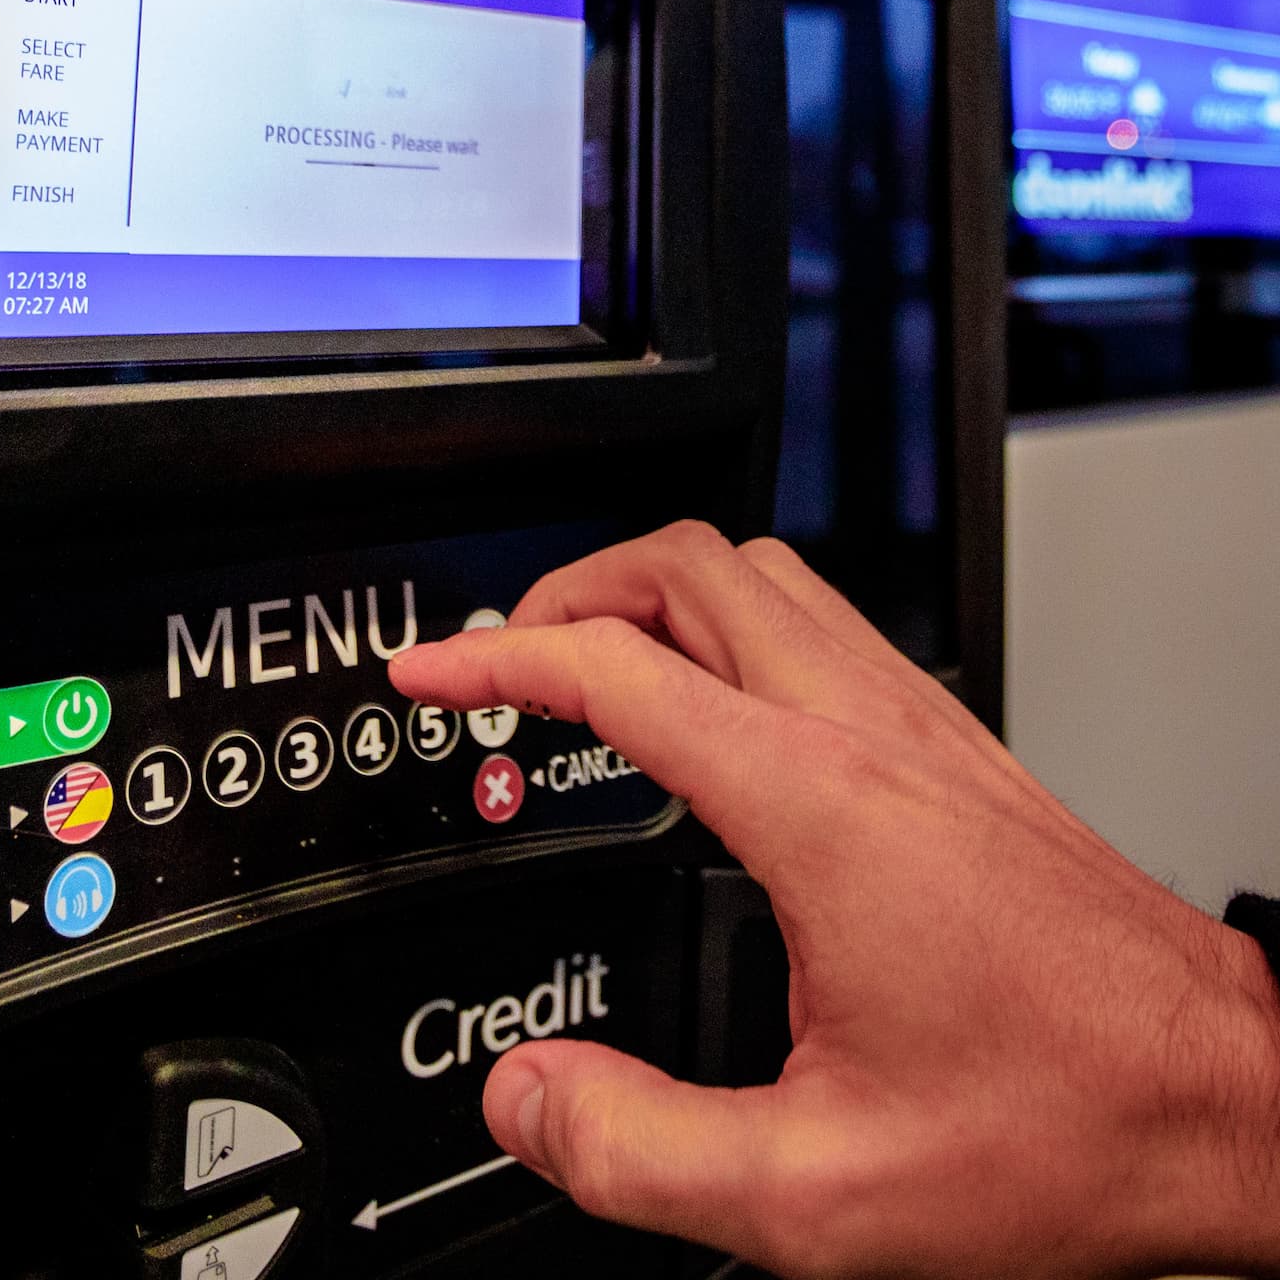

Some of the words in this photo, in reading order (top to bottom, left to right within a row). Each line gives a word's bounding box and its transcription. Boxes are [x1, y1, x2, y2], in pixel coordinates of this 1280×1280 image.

[21, 38, 87, 59] SELECT
[21, 62, 65, 81] FARE
[18, 108, 69, 128] MAKE
[16, 133, 105, 154] PAYMENT
[264, 124, 376, 150] PROCESSING
[391, 132, 443, 154] Please
[445, 138, 480, 156] wait
[12, 184, 75, 204] FINISH
[7, 271, 87, 290] 12/13/18
[3, 296, 55, 316] 07:27
[58, 296, 90, 315] AM
[167, 580, 418, 700] MENU
[142, 761, 175, 814] 1
[217, 746, 250, 797] 2
[289, 731, 320, 780] 3
[354, 717, 387, 762] 4
[419, 705, 448, 750] 5
[401, 952, 610, 1079] Credit
